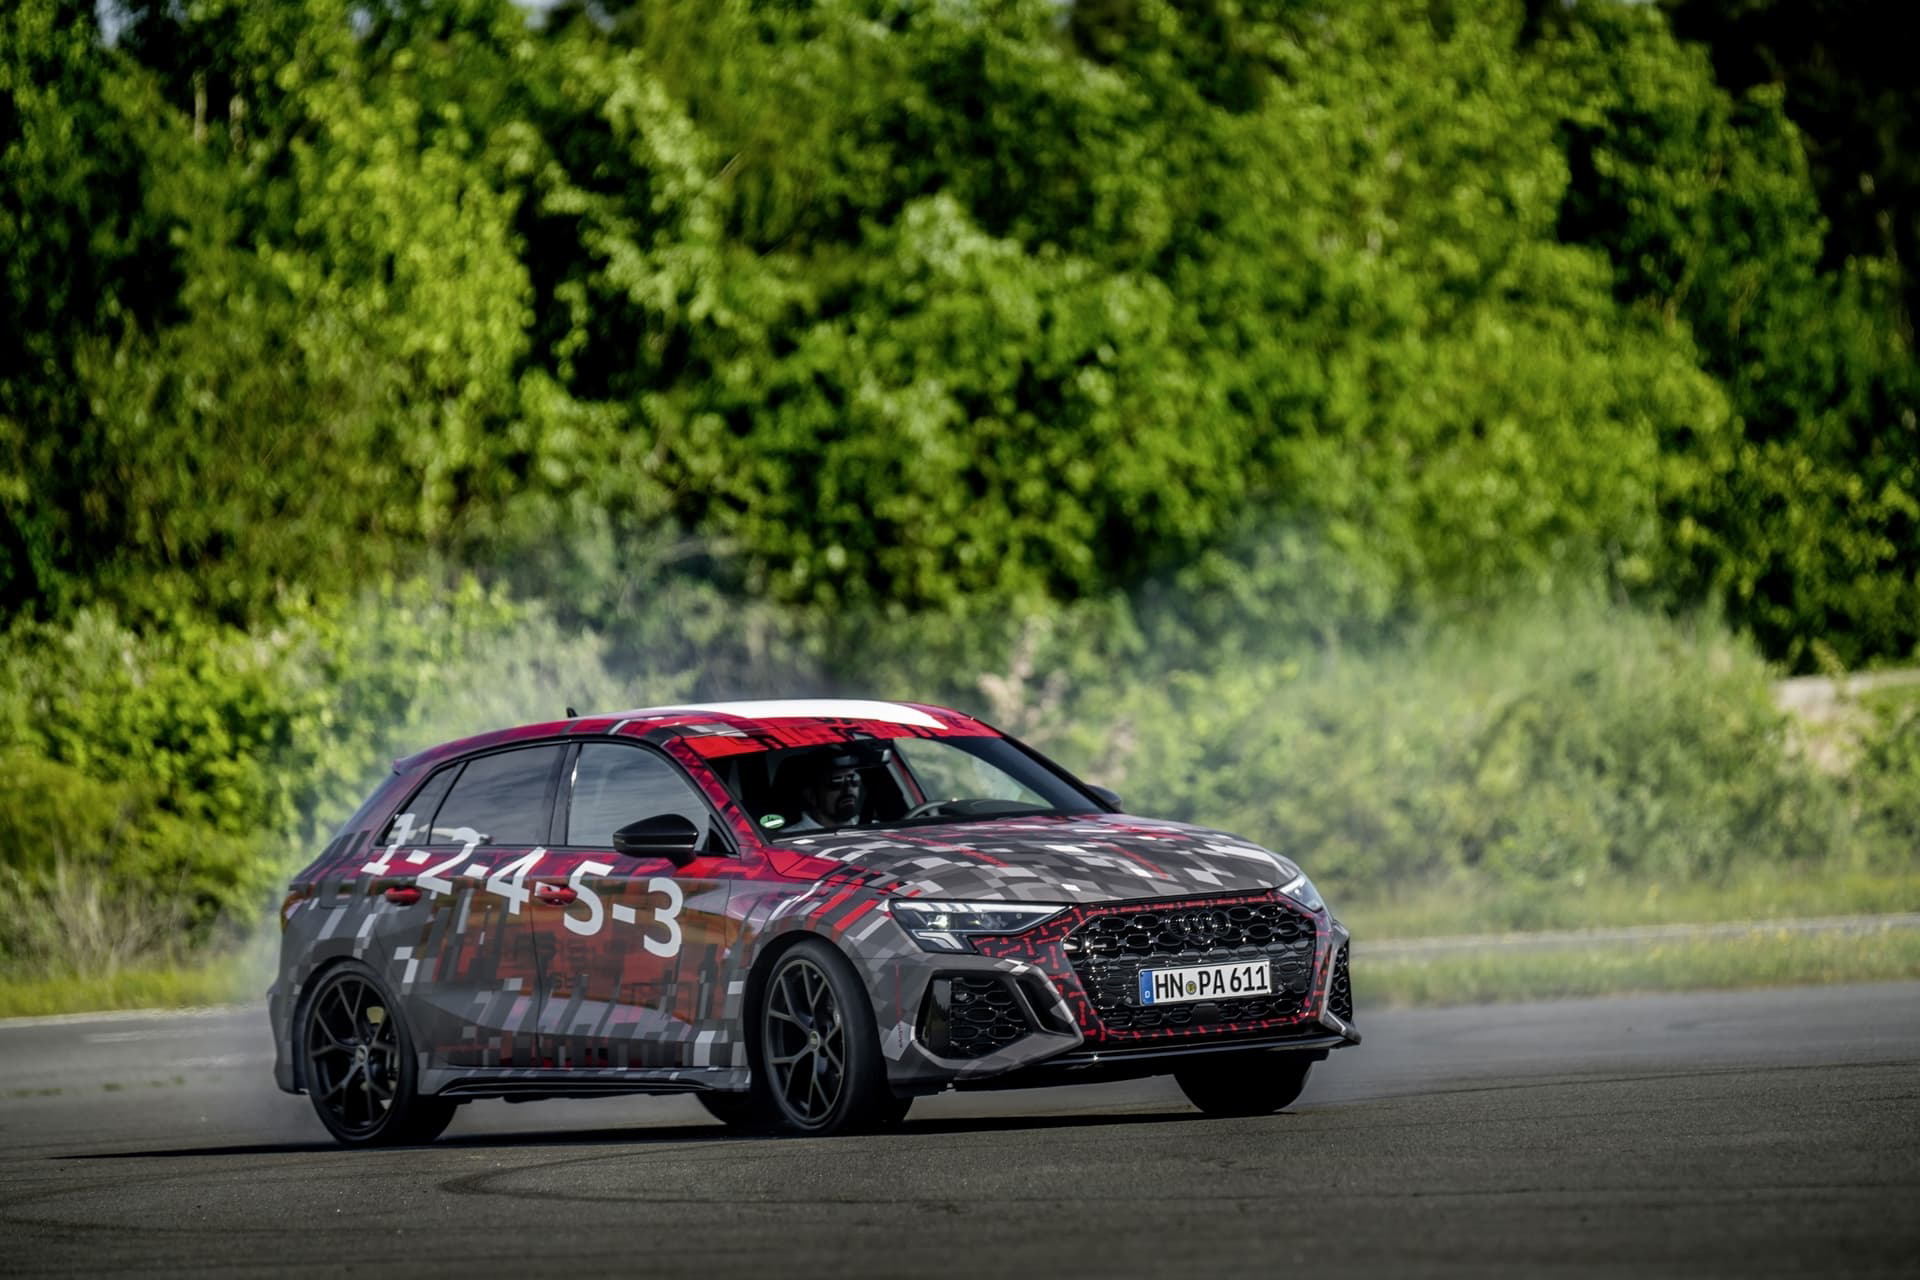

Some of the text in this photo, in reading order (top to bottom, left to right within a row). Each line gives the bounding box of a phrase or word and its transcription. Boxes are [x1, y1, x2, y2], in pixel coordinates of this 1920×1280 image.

[1155, 966, 1267, 999] HN PA 611
